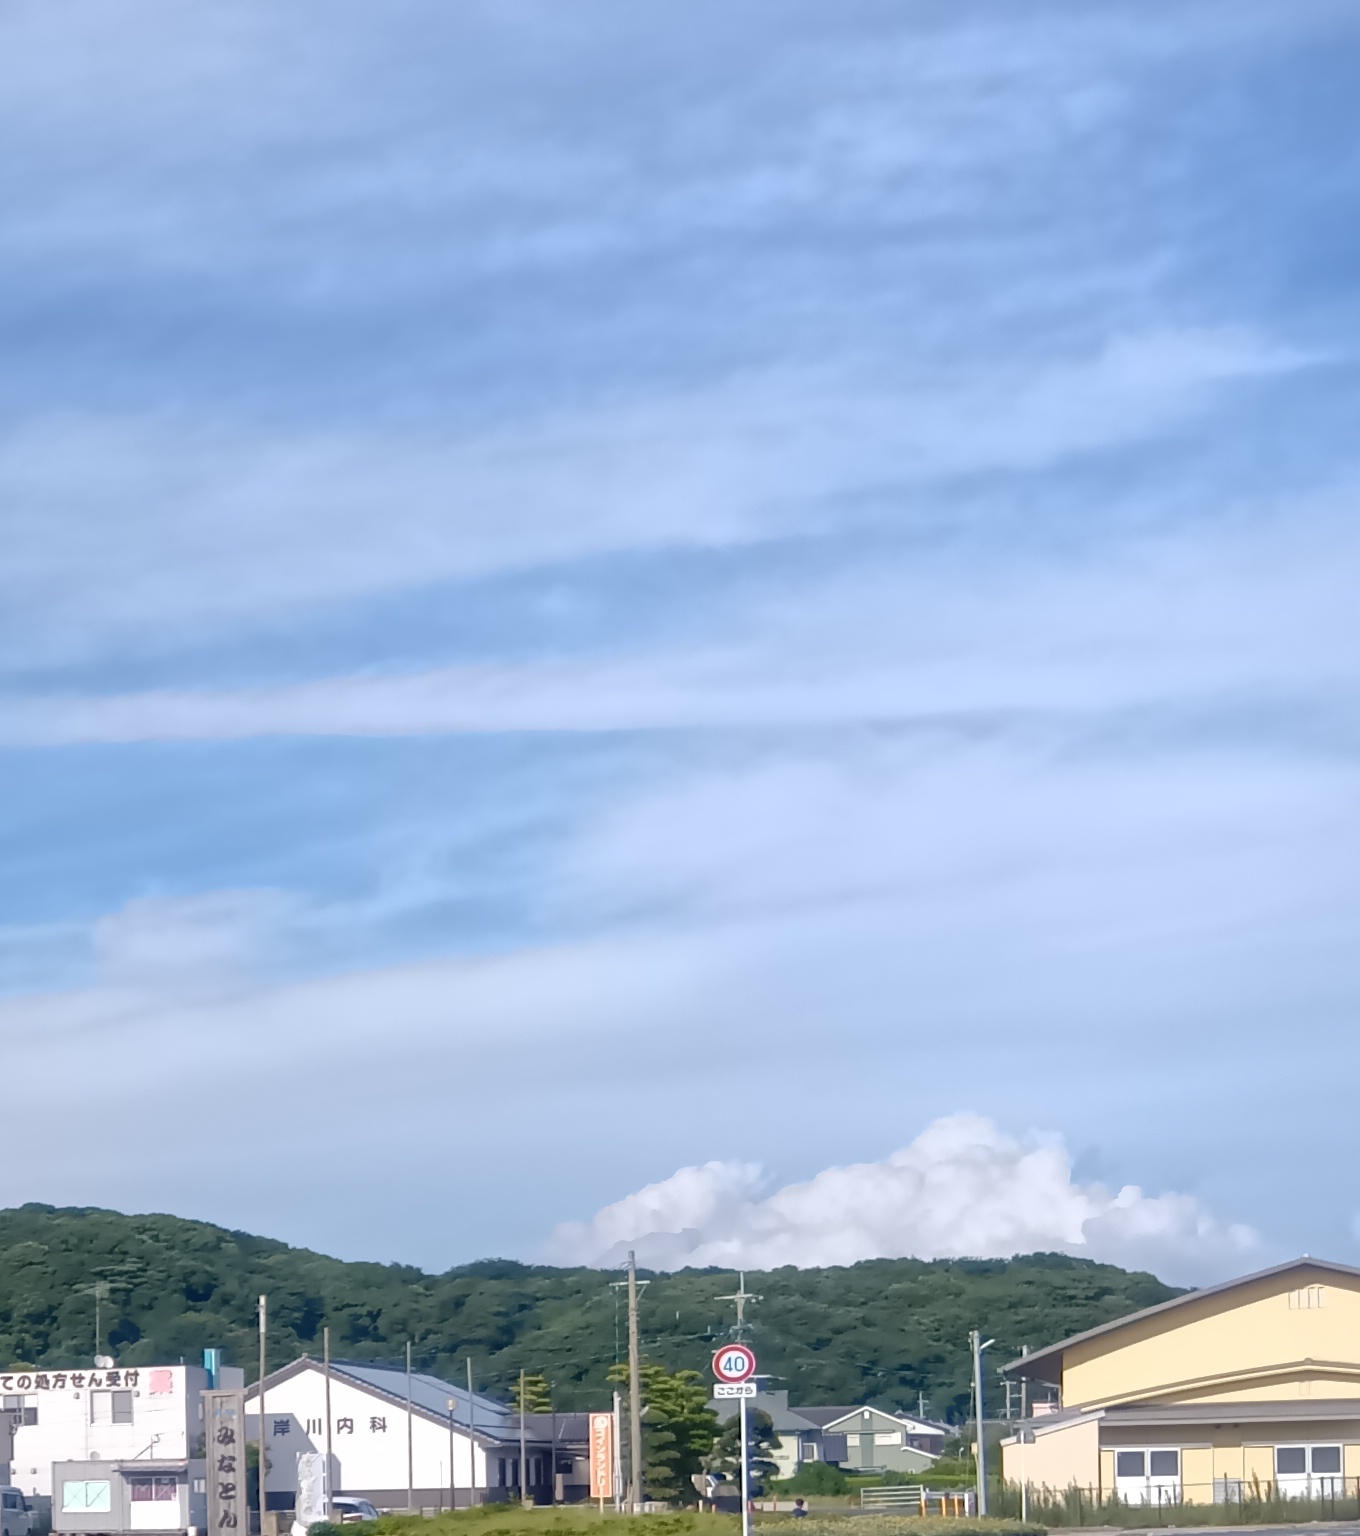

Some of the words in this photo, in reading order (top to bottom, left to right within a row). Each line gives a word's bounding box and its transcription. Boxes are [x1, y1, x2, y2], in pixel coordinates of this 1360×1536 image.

[722, 1356, 745, 1372] 40
[717, 1386, 753, 1396] ここから
[273, 1416, 387, 1436] 岸川内科
